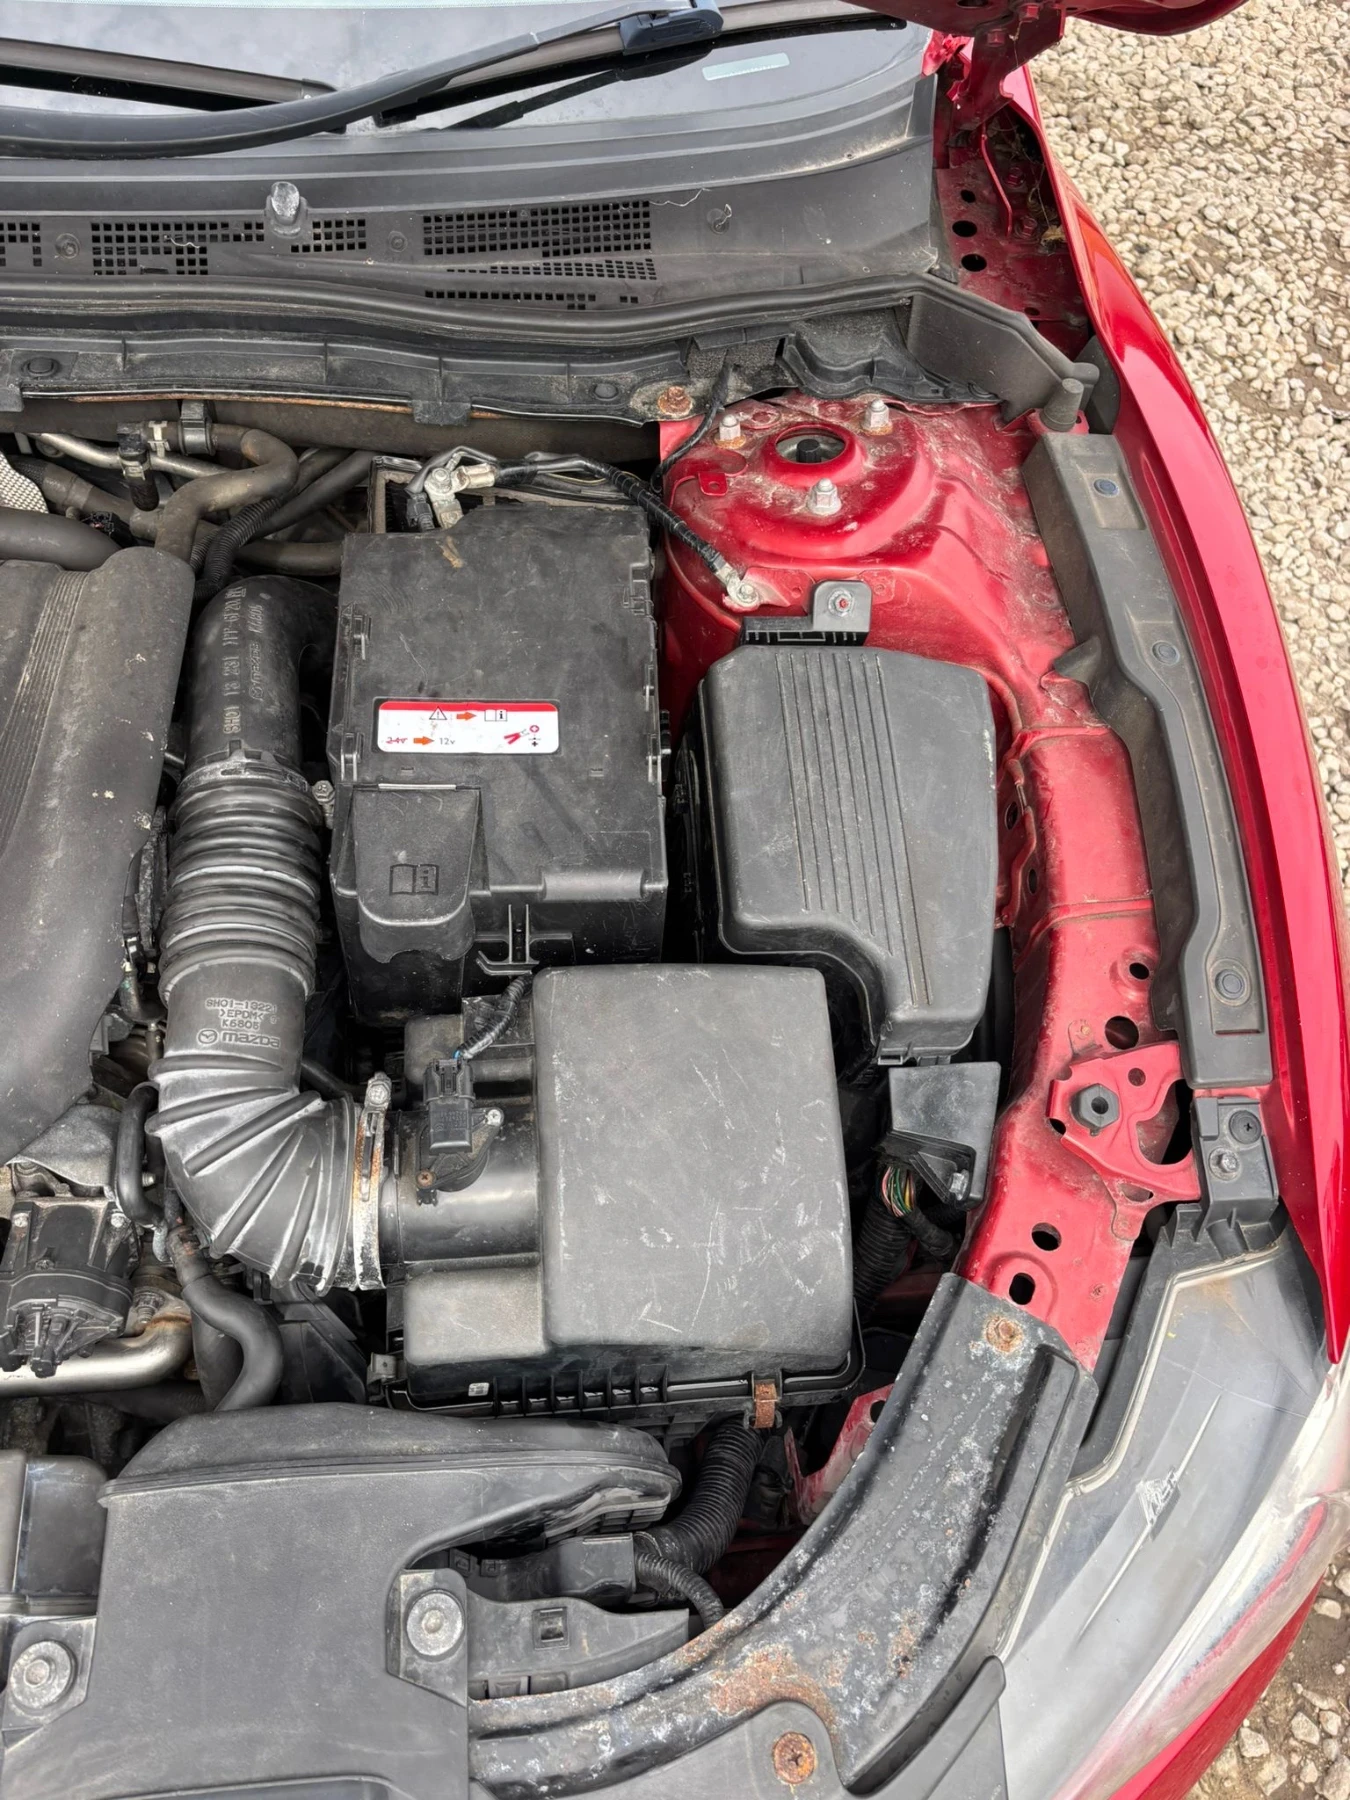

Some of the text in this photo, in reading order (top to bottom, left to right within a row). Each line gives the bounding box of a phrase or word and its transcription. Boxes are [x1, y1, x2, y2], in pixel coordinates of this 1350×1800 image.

[439, 737, 456, 746] 12v
[222, 1019, 260, 1031] K6805
[222, 1031, 280, 1049] mazda
